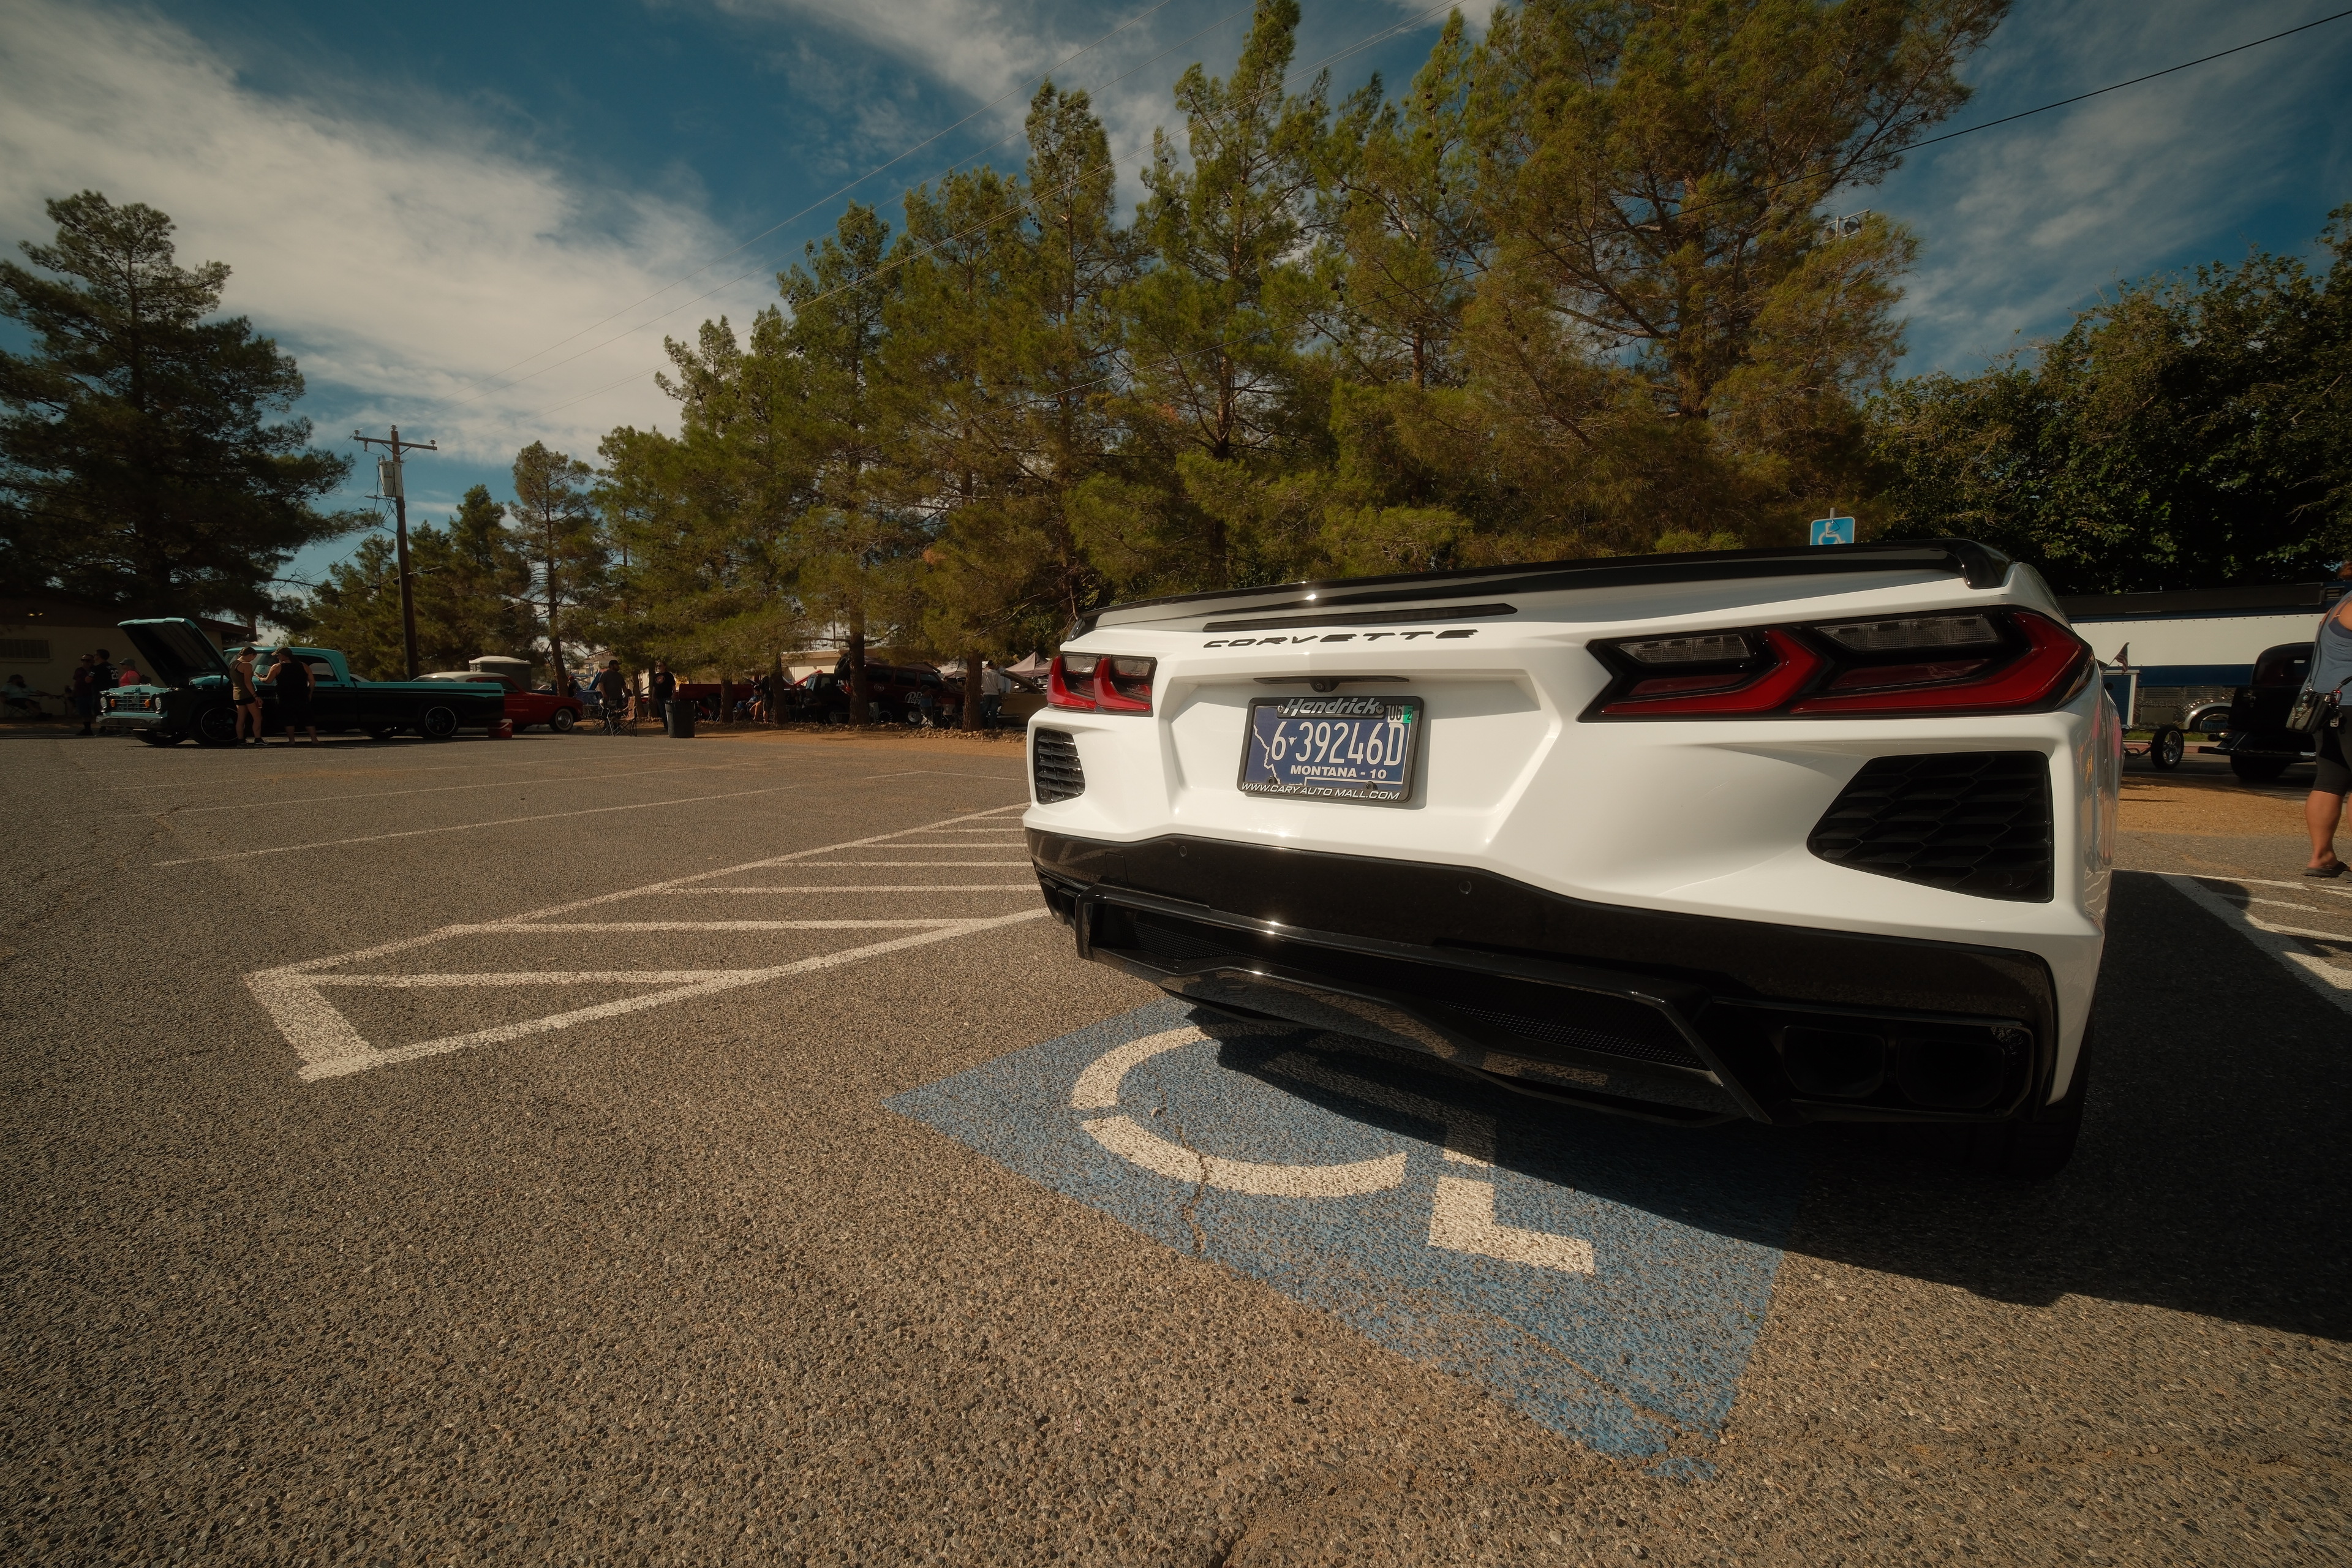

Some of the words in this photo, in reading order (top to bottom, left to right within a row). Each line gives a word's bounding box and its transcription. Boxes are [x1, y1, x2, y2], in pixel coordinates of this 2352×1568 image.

[1204, 629, 1479, 648] CORVETTE
[1283, 698, 1381, 717] Hendrick
[1291, 765, 1357, 777] MONTANA
[1370, 769, 1387, 779] 10
[1241, 783, 1300, 794] WWW.CARY
[1299, 787, 1333, 796] AUTO
[1334, 789, 1400, 800] MALL.COM
